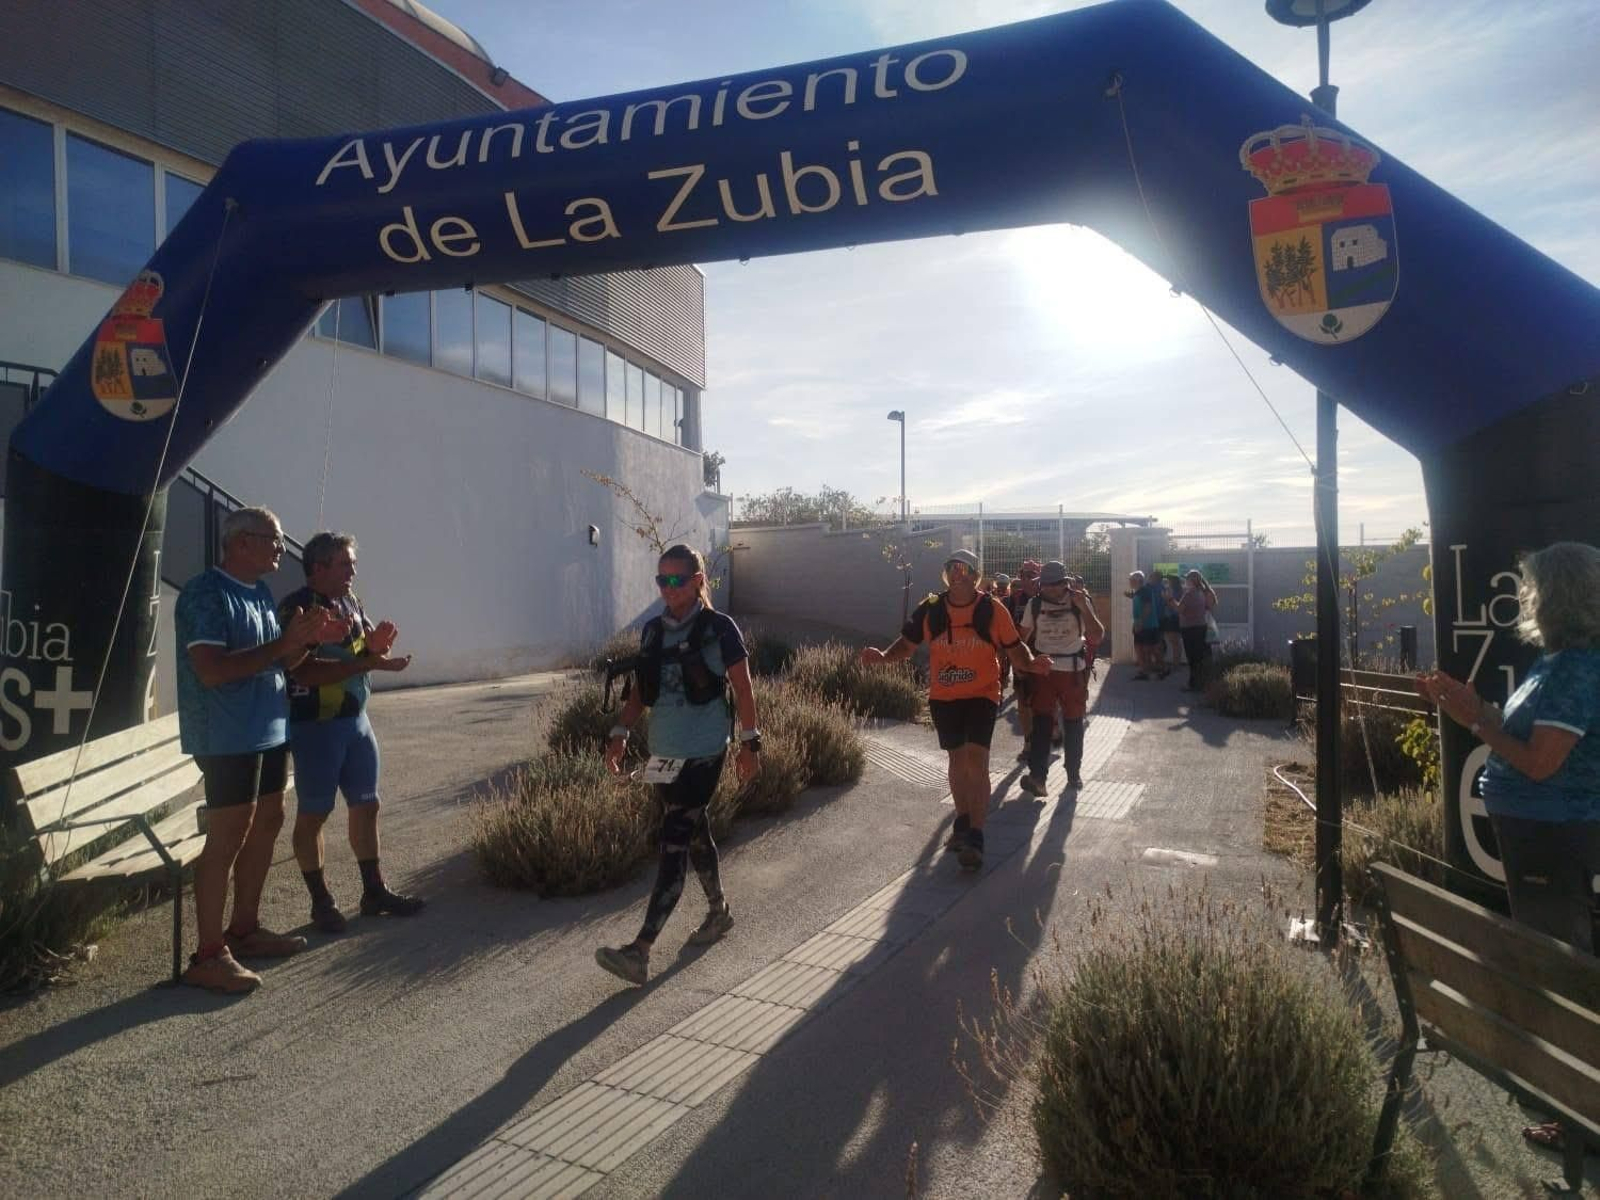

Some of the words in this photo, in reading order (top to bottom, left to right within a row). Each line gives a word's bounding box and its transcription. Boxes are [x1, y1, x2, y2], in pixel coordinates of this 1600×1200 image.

[315, 49, 968, 193] Ayuntamiento
[379, 206, 481, 263] de
[505, 192, 622, 249] La
[648, 140, 939, 232] Zubia
